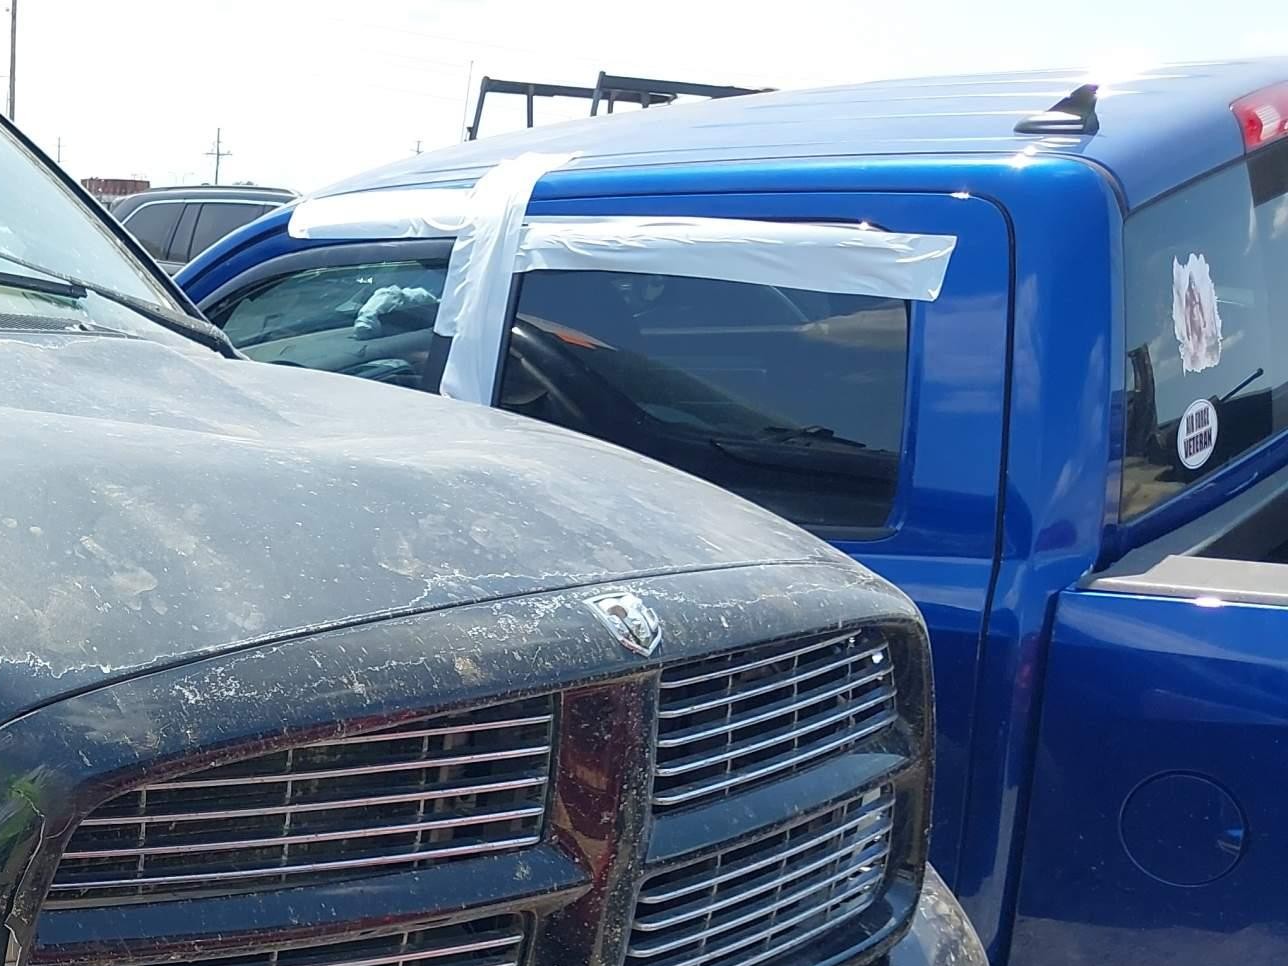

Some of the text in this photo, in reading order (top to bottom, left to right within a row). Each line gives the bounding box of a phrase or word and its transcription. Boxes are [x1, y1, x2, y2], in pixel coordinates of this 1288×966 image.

[1185, 406, 1210, 436] AIR FORCE
[1183, 427, 1213, 459] VETERAN
